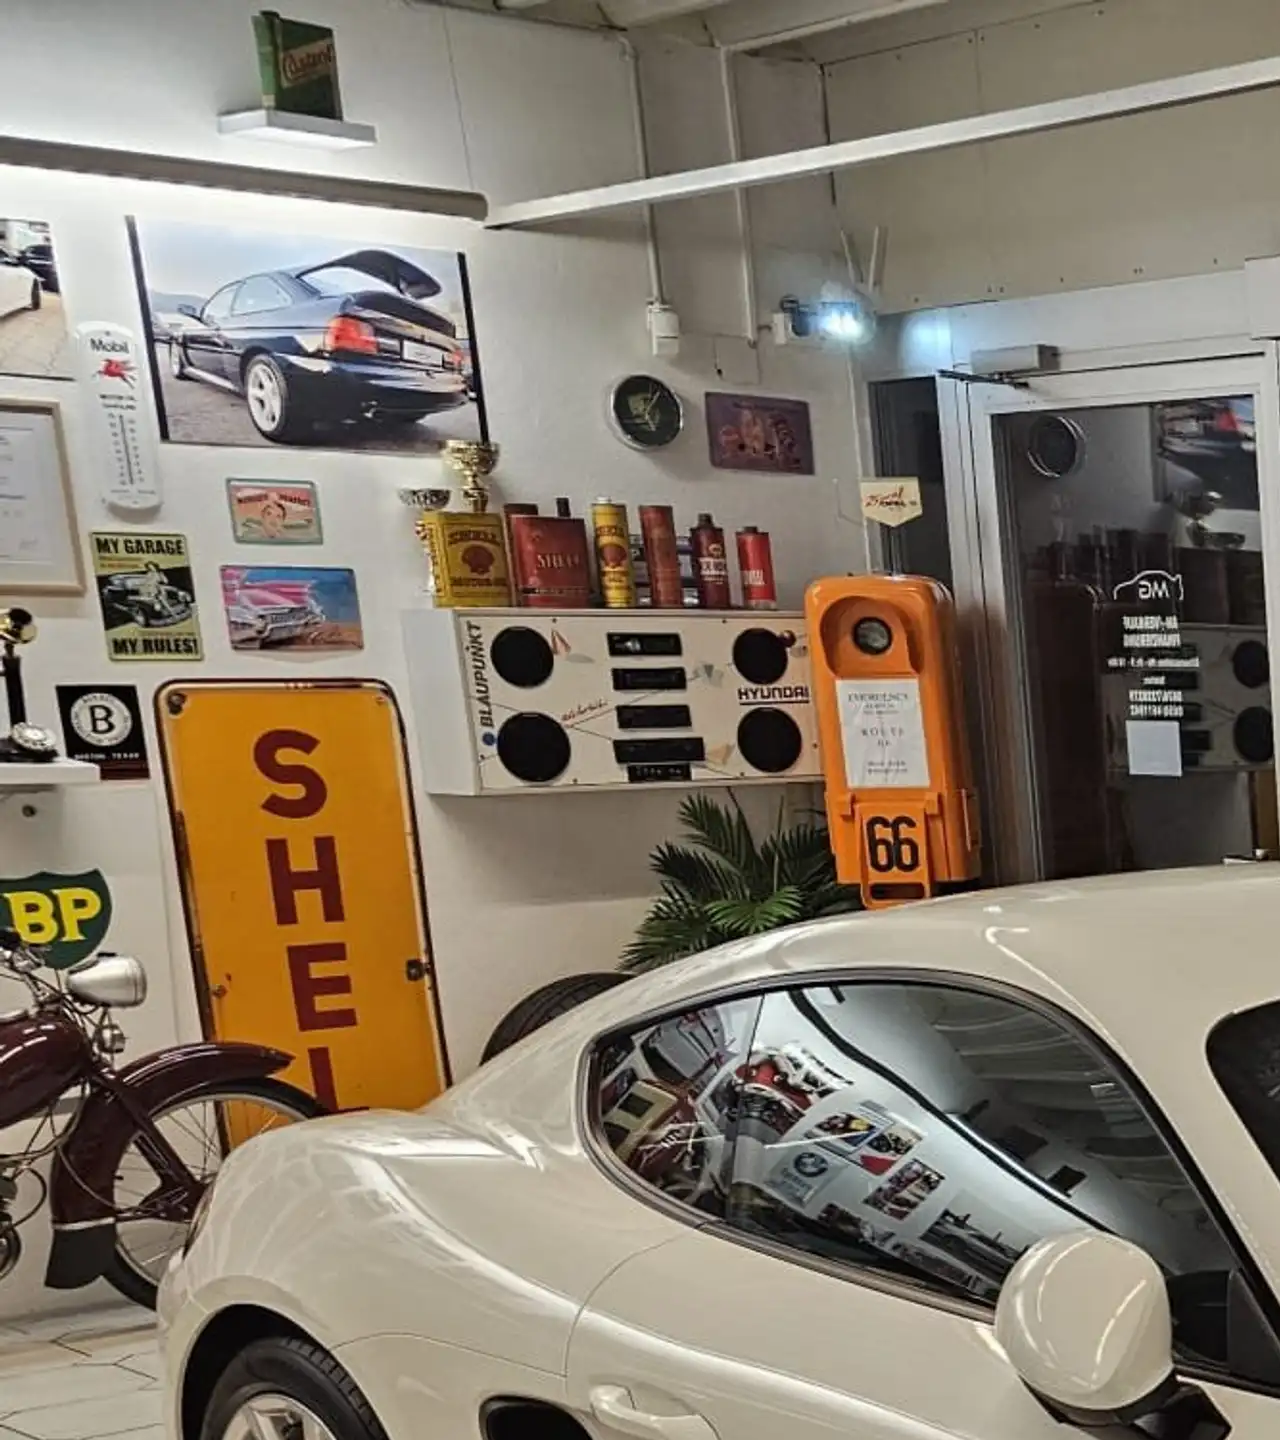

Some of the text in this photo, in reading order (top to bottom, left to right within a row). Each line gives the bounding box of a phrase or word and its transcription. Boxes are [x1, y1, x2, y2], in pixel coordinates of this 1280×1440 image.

[90, 337, 130, 354] Mobil
[95, 537, 184, 555] MY GARAGE
[112, 637, 139, 654] MY
[466, 620, 495, 729] BLAUPUNKT
[737, 685, 809, 701] HYUNDAI
[89, 704, 116, 734] B
[866, 815, 920, 873] 66
[3, 887, 102, 944] BP
